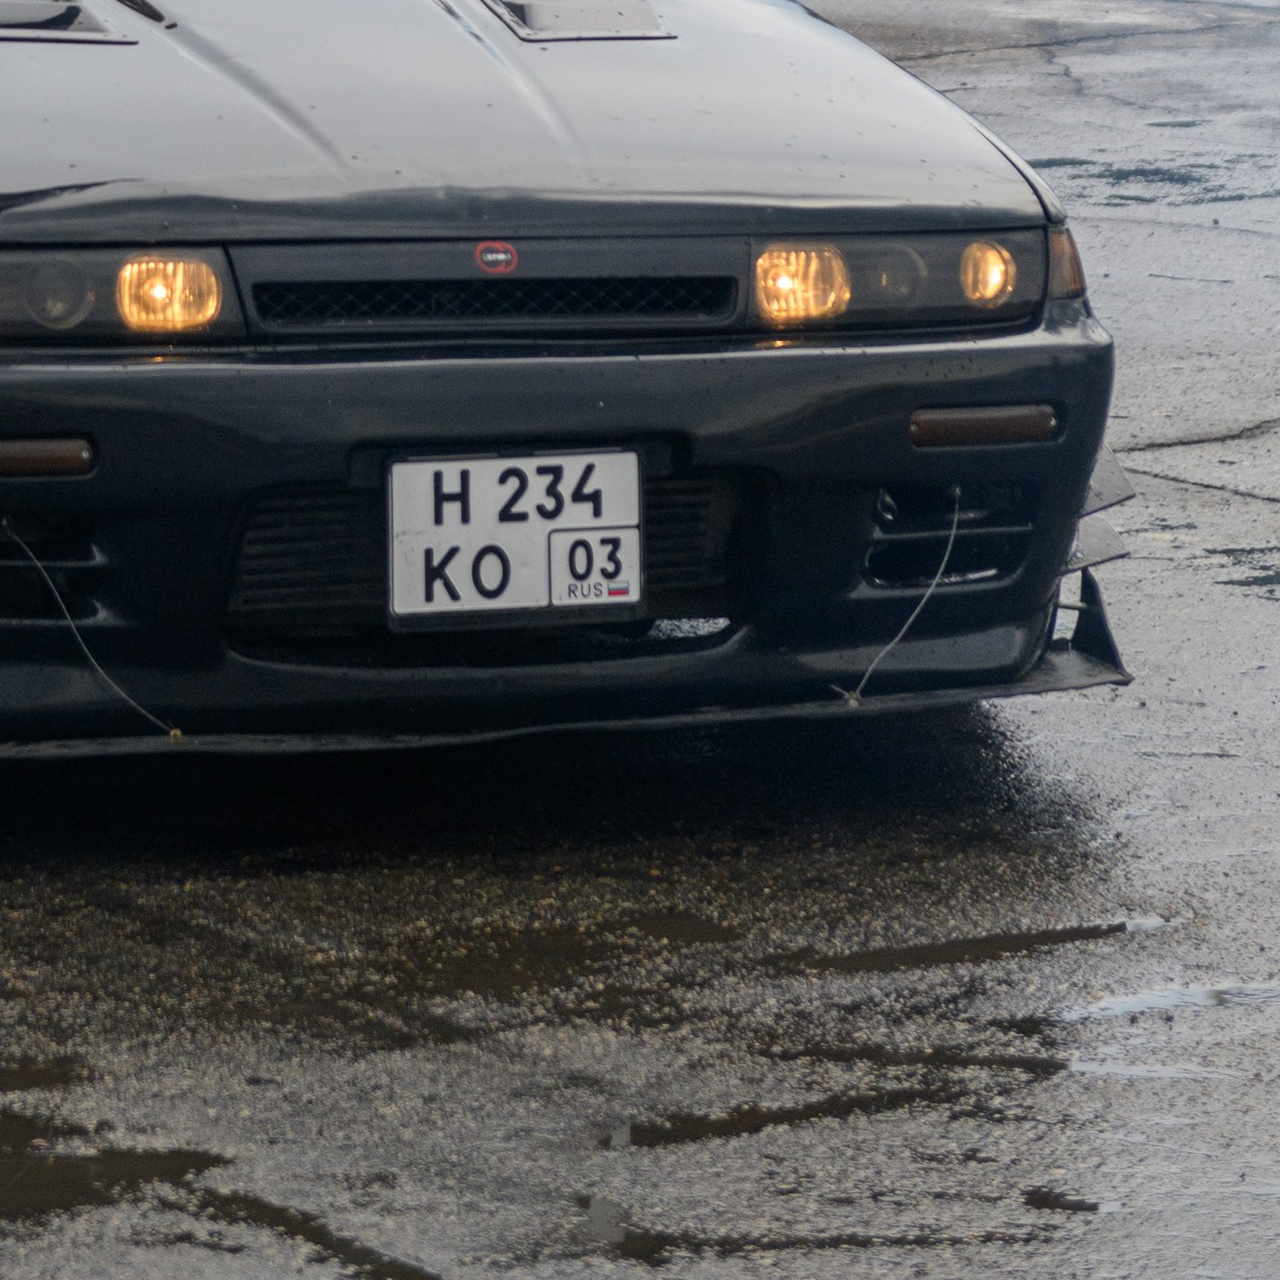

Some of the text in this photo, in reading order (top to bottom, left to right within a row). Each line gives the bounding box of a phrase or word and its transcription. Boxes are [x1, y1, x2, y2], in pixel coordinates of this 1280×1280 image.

[497, 462, 603, 523] 234
[567, 536, 623, 581] 03
[567, 582, 604, 598] RUS
